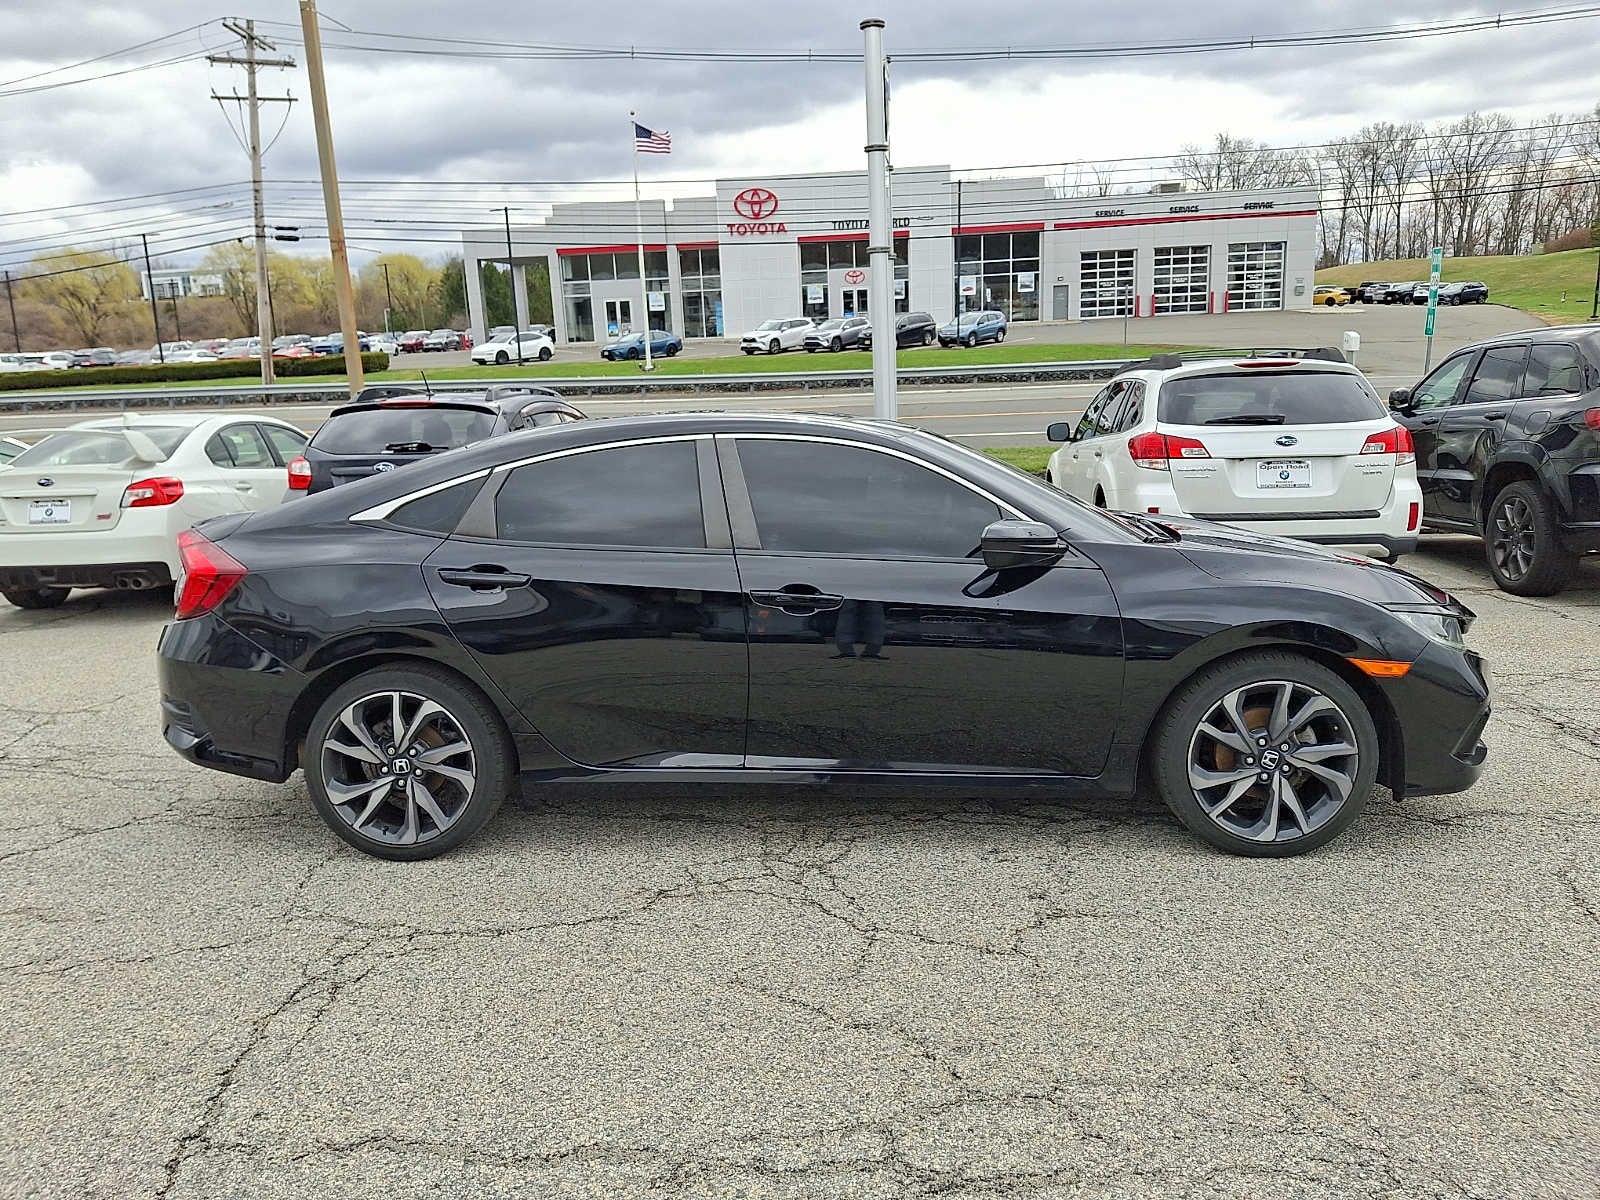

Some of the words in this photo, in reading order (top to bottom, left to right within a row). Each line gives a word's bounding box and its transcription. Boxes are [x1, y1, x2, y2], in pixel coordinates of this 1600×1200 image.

[1169, 205, 1200, 214] SERVICE
[1243, 201, 1275, 210] SERVICE
[1095, 209, 1126, 217] SERVICE
[727, 222, 788, 236] TOYOTA
[832, 219, 870, 230] TOYOTA
